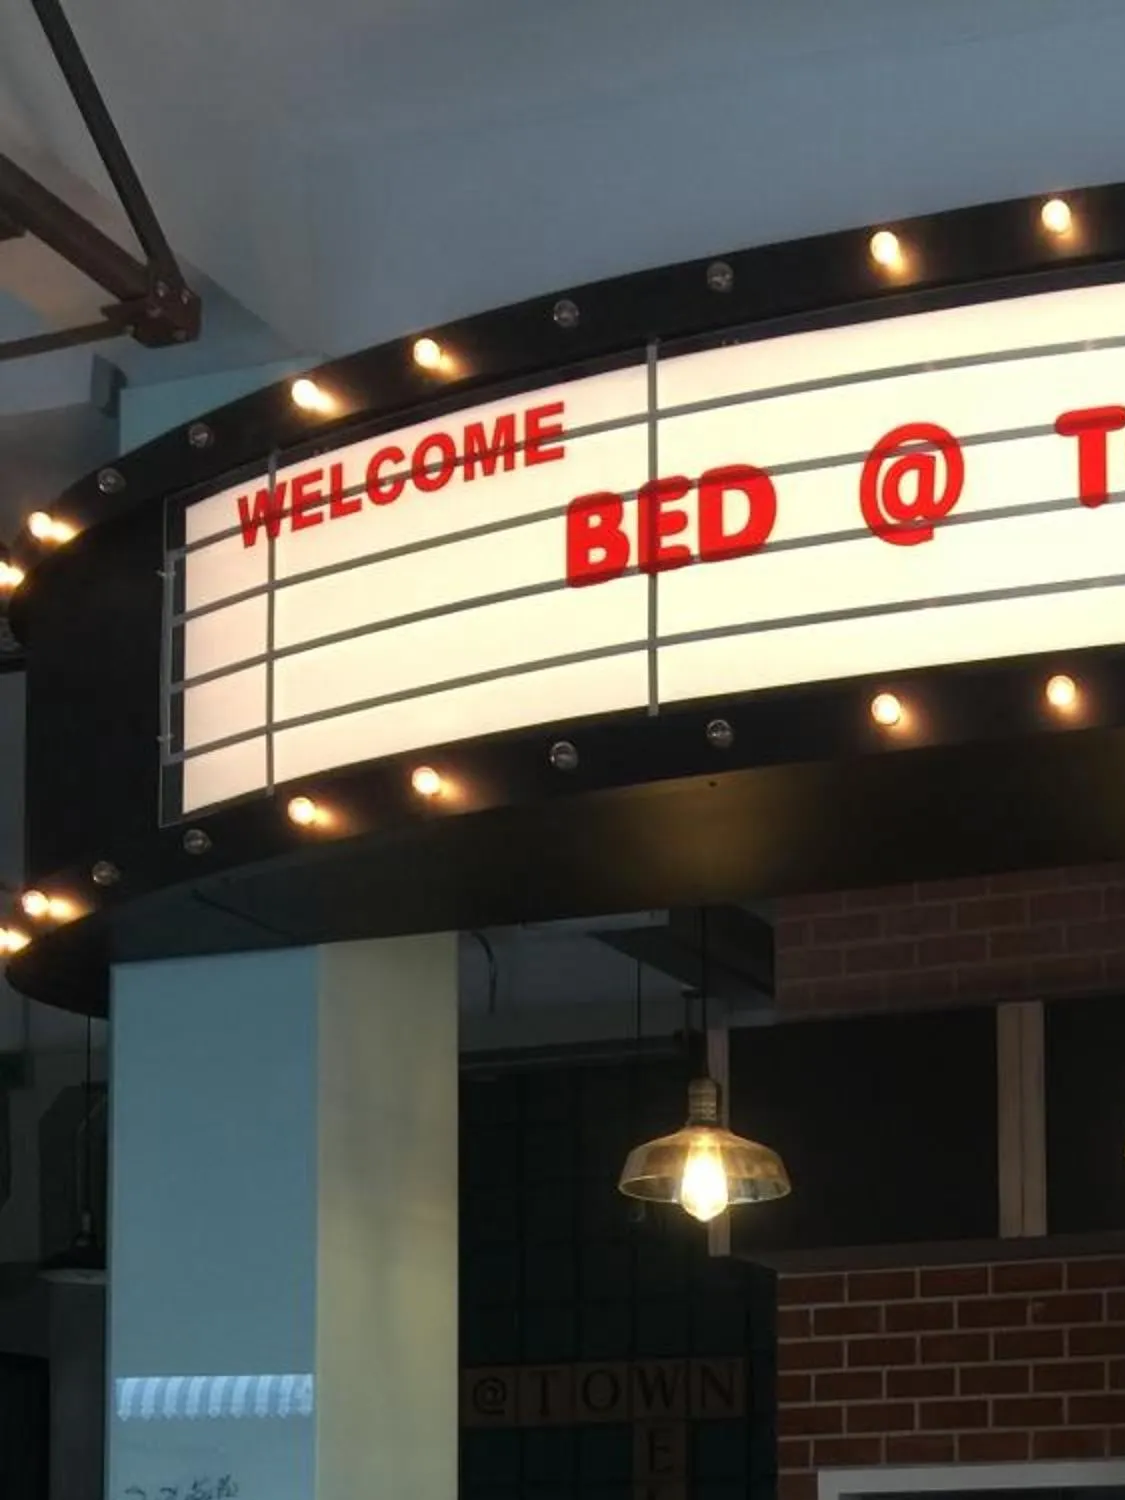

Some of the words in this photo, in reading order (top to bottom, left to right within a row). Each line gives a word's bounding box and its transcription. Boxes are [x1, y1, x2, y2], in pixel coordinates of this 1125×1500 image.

[237, 401, 565, 548] WELCOME
[565, 463, 778, 587] BED
[858, 422, 965, 546] @
[471, 1364, 737, 1416] @TOWN
